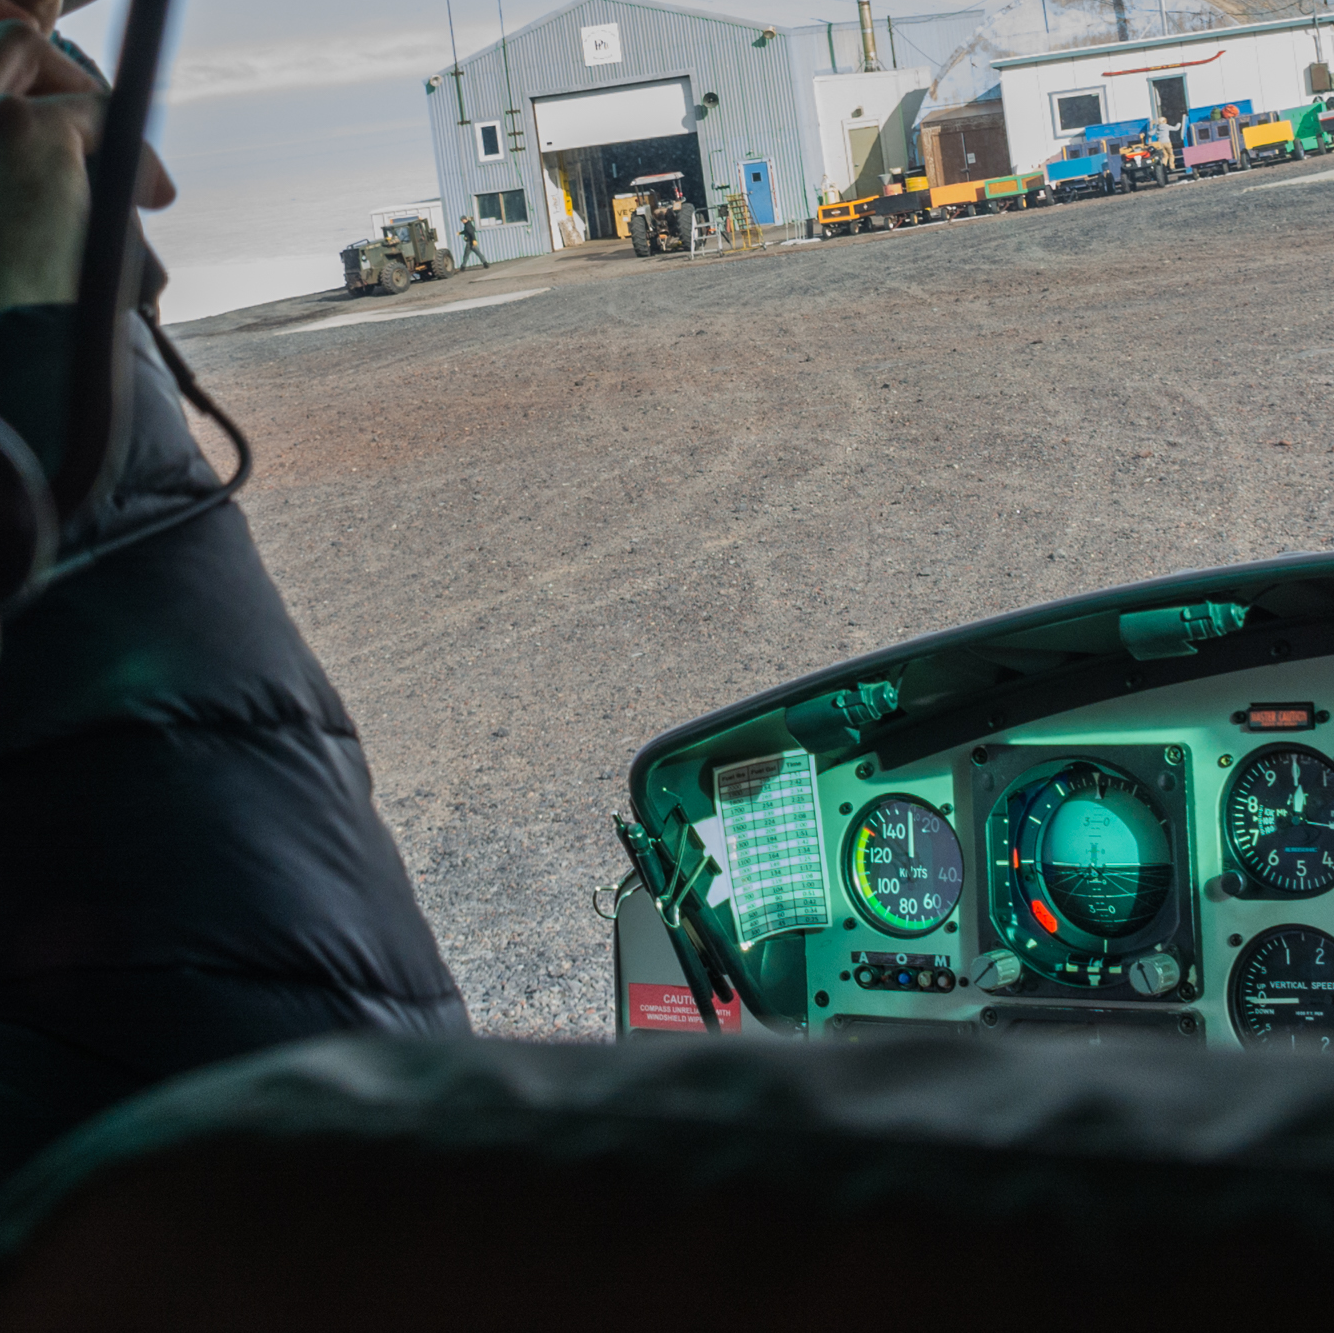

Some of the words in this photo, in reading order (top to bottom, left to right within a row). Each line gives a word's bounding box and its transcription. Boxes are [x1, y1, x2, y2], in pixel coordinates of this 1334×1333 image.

[883, 823, 906, 839] 140
[922, 817, 940, 833] 20
[871, 847, 892, 863] 120
[938, 867, 957, 882] 40
[878, 878, 899, 894] 100
[899, 898, 917, 914] 80
[923, 893, 941, 909] 60
[859, 952, 868, 963] A
[896, 953, 907, 964] O
[934, 956, 947, 967] M
[1270, 981, 1308, 989] VERTICAL
[663, 994, 696, 1004] CAUTI
[640, 1005, 671, 1013] COMPASS
[647, 1014, 686, 1022] WINDSHIELD
